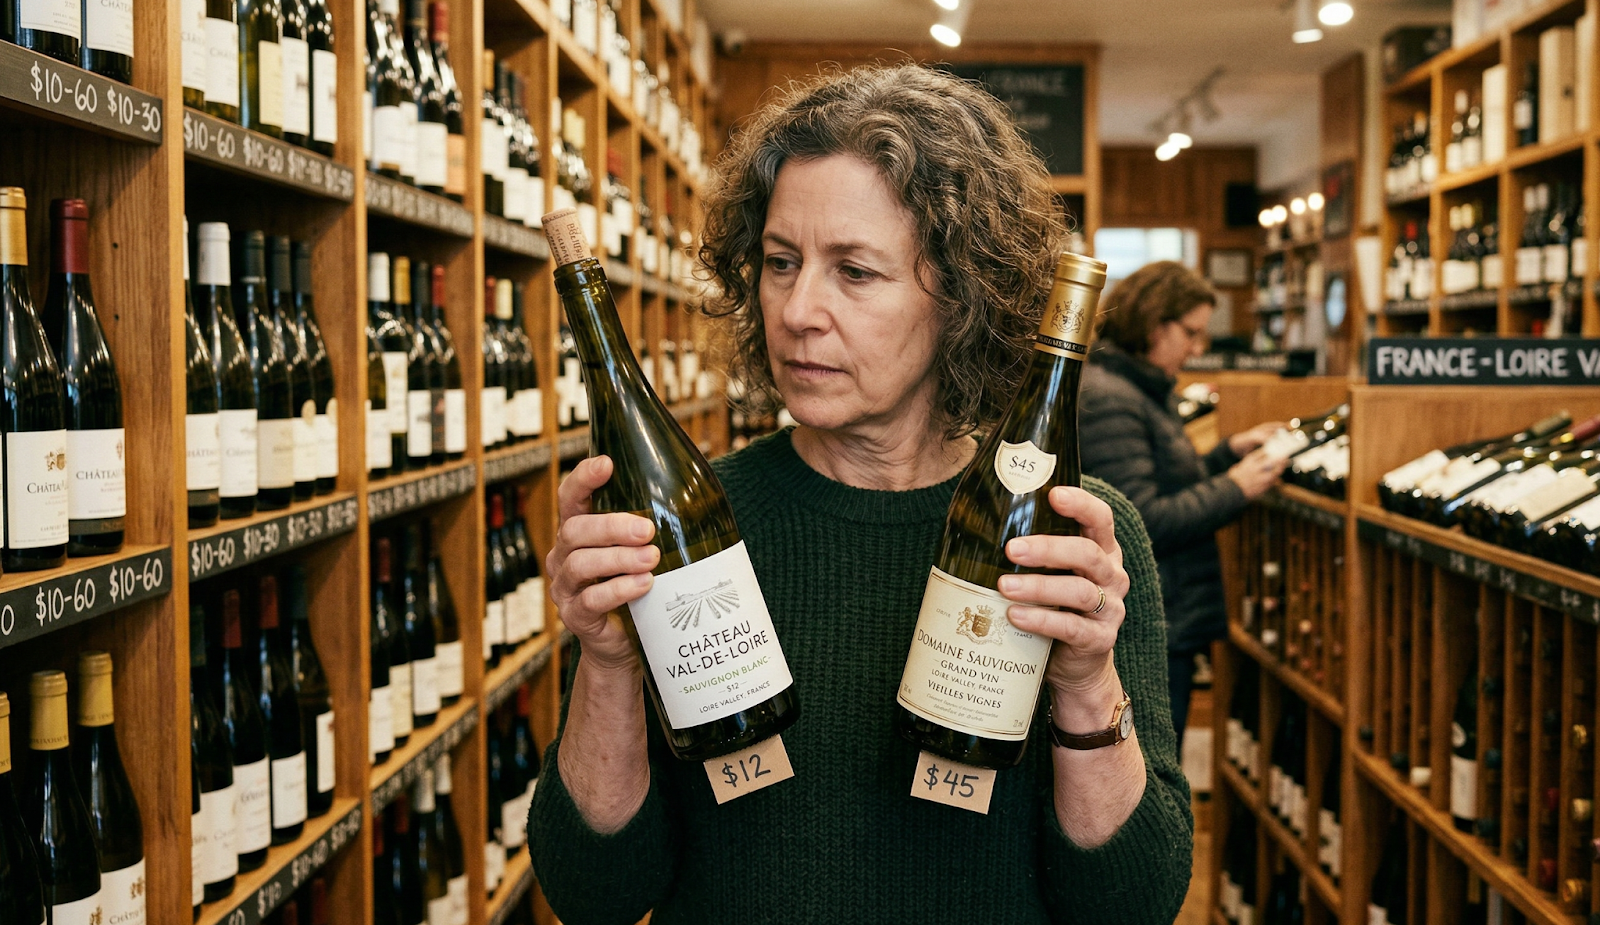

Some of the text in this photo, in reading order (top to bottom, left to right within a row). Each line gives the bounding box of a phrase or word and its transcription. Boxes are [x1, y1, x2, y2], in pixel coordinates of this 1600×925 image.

[31, 61, 161, 134] $10-60 $10-30
[183, 112, 235, 159] $10-60
[1009, 455, 1036, 473] $45
[191, 536, 235, 577] $10-60
[35, 577, 96, 627] $10-60
[109, 557, 163, 605] $10-60
[666, 630, 769, 679] VAL-DE-LOIRE
[678, 620, 751, 659] CHÂTEAU
[917, 628, 1037, 675] DOMAINE SAUVIGNON
[931, 668, 949, 681] LOIRE
[978, 684, 1004, 696] FRANCE
[940, 659, 1000, 684] GRAND VIN
[699, 702, 719, 714] LOIRE
[928, 679, 964, 700] VIEILLES
[967, 693, 1002, 709] VIGNES
[721, 753, 771, 788] $12
[923, 763, 979, 798] $45
